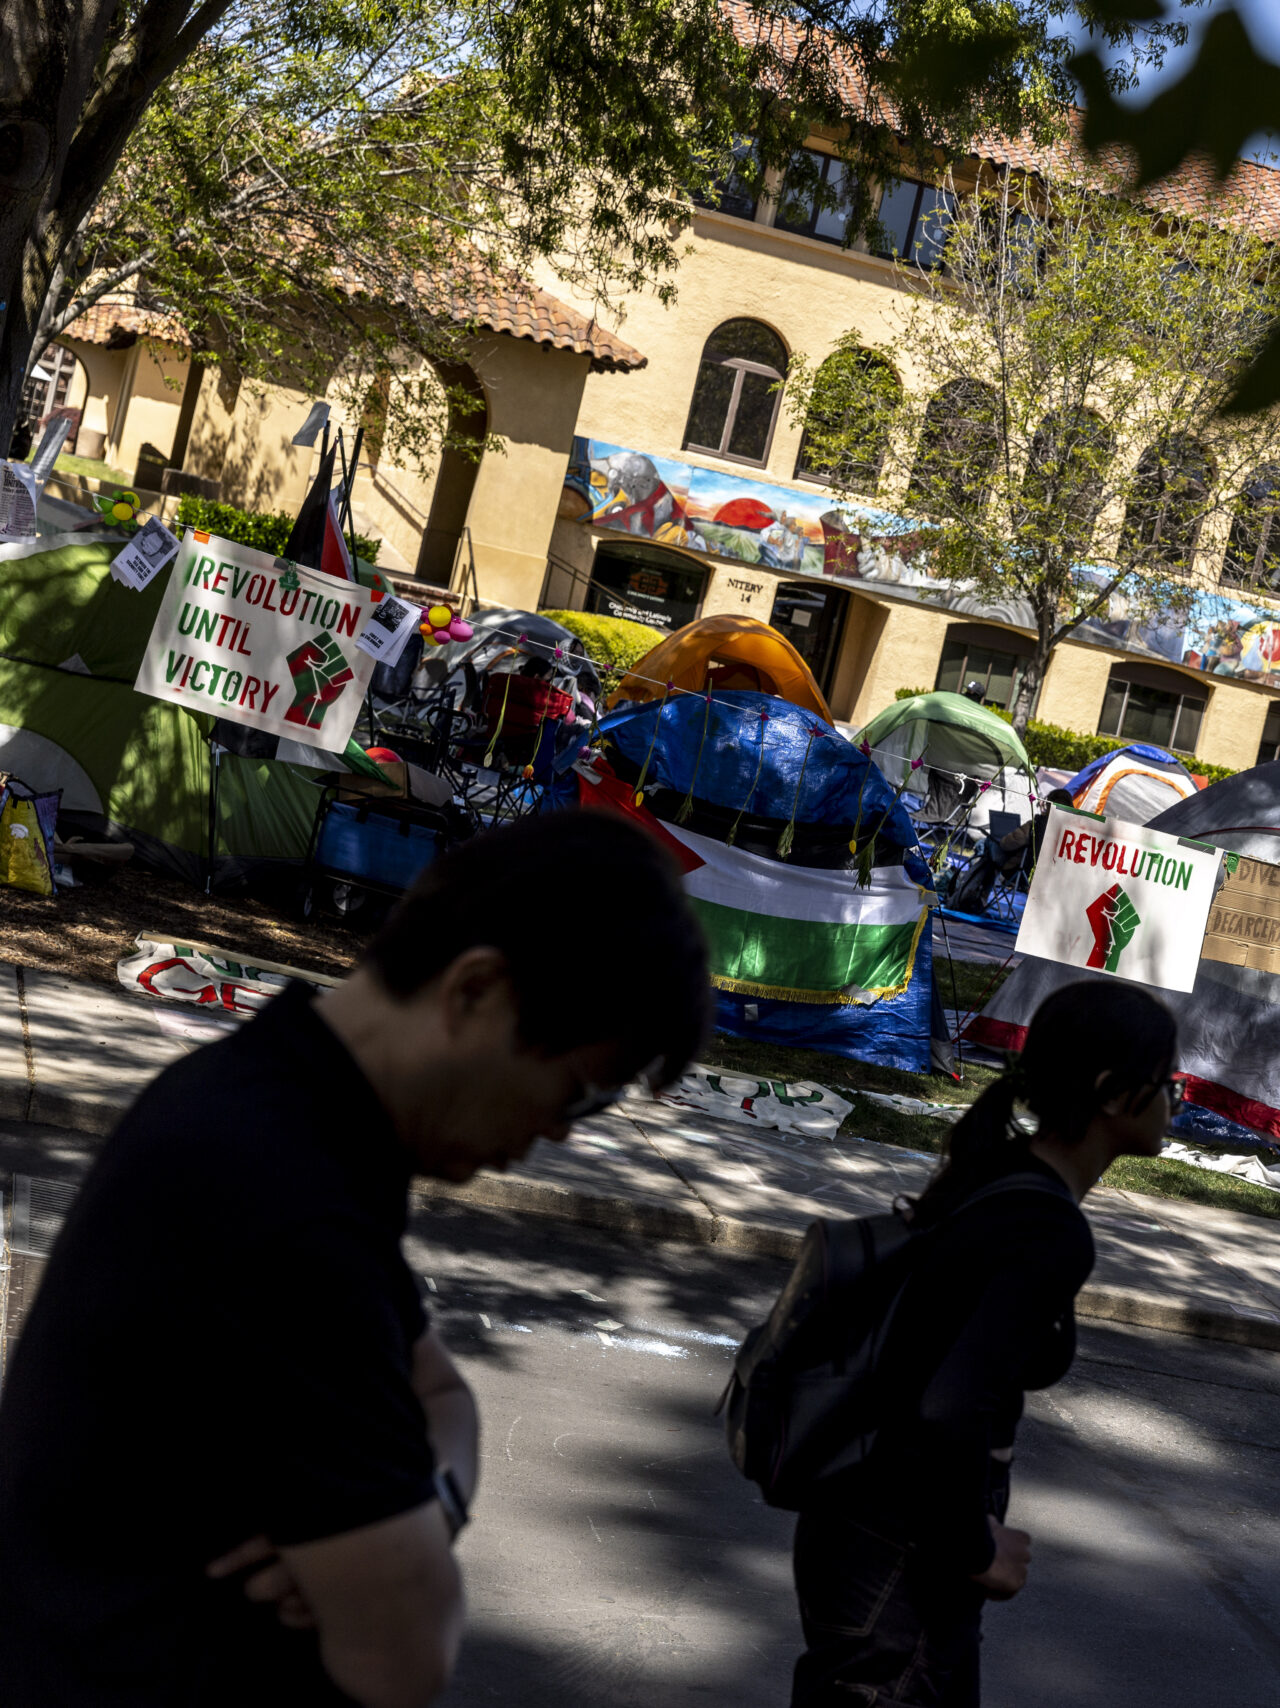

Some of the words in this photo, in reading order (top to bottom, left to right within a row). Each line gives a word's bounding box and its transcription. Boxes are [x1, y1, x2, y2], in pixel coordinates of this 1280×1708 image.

[192, 555, 362, 638] REVOLUTION
[740, 593, 752, 604] 14
[177, 602, 252, 657] UNTIL
[165, 649, 280, 714] VICTORY
[1058, 829, 1194, 891] REVOLUTION
